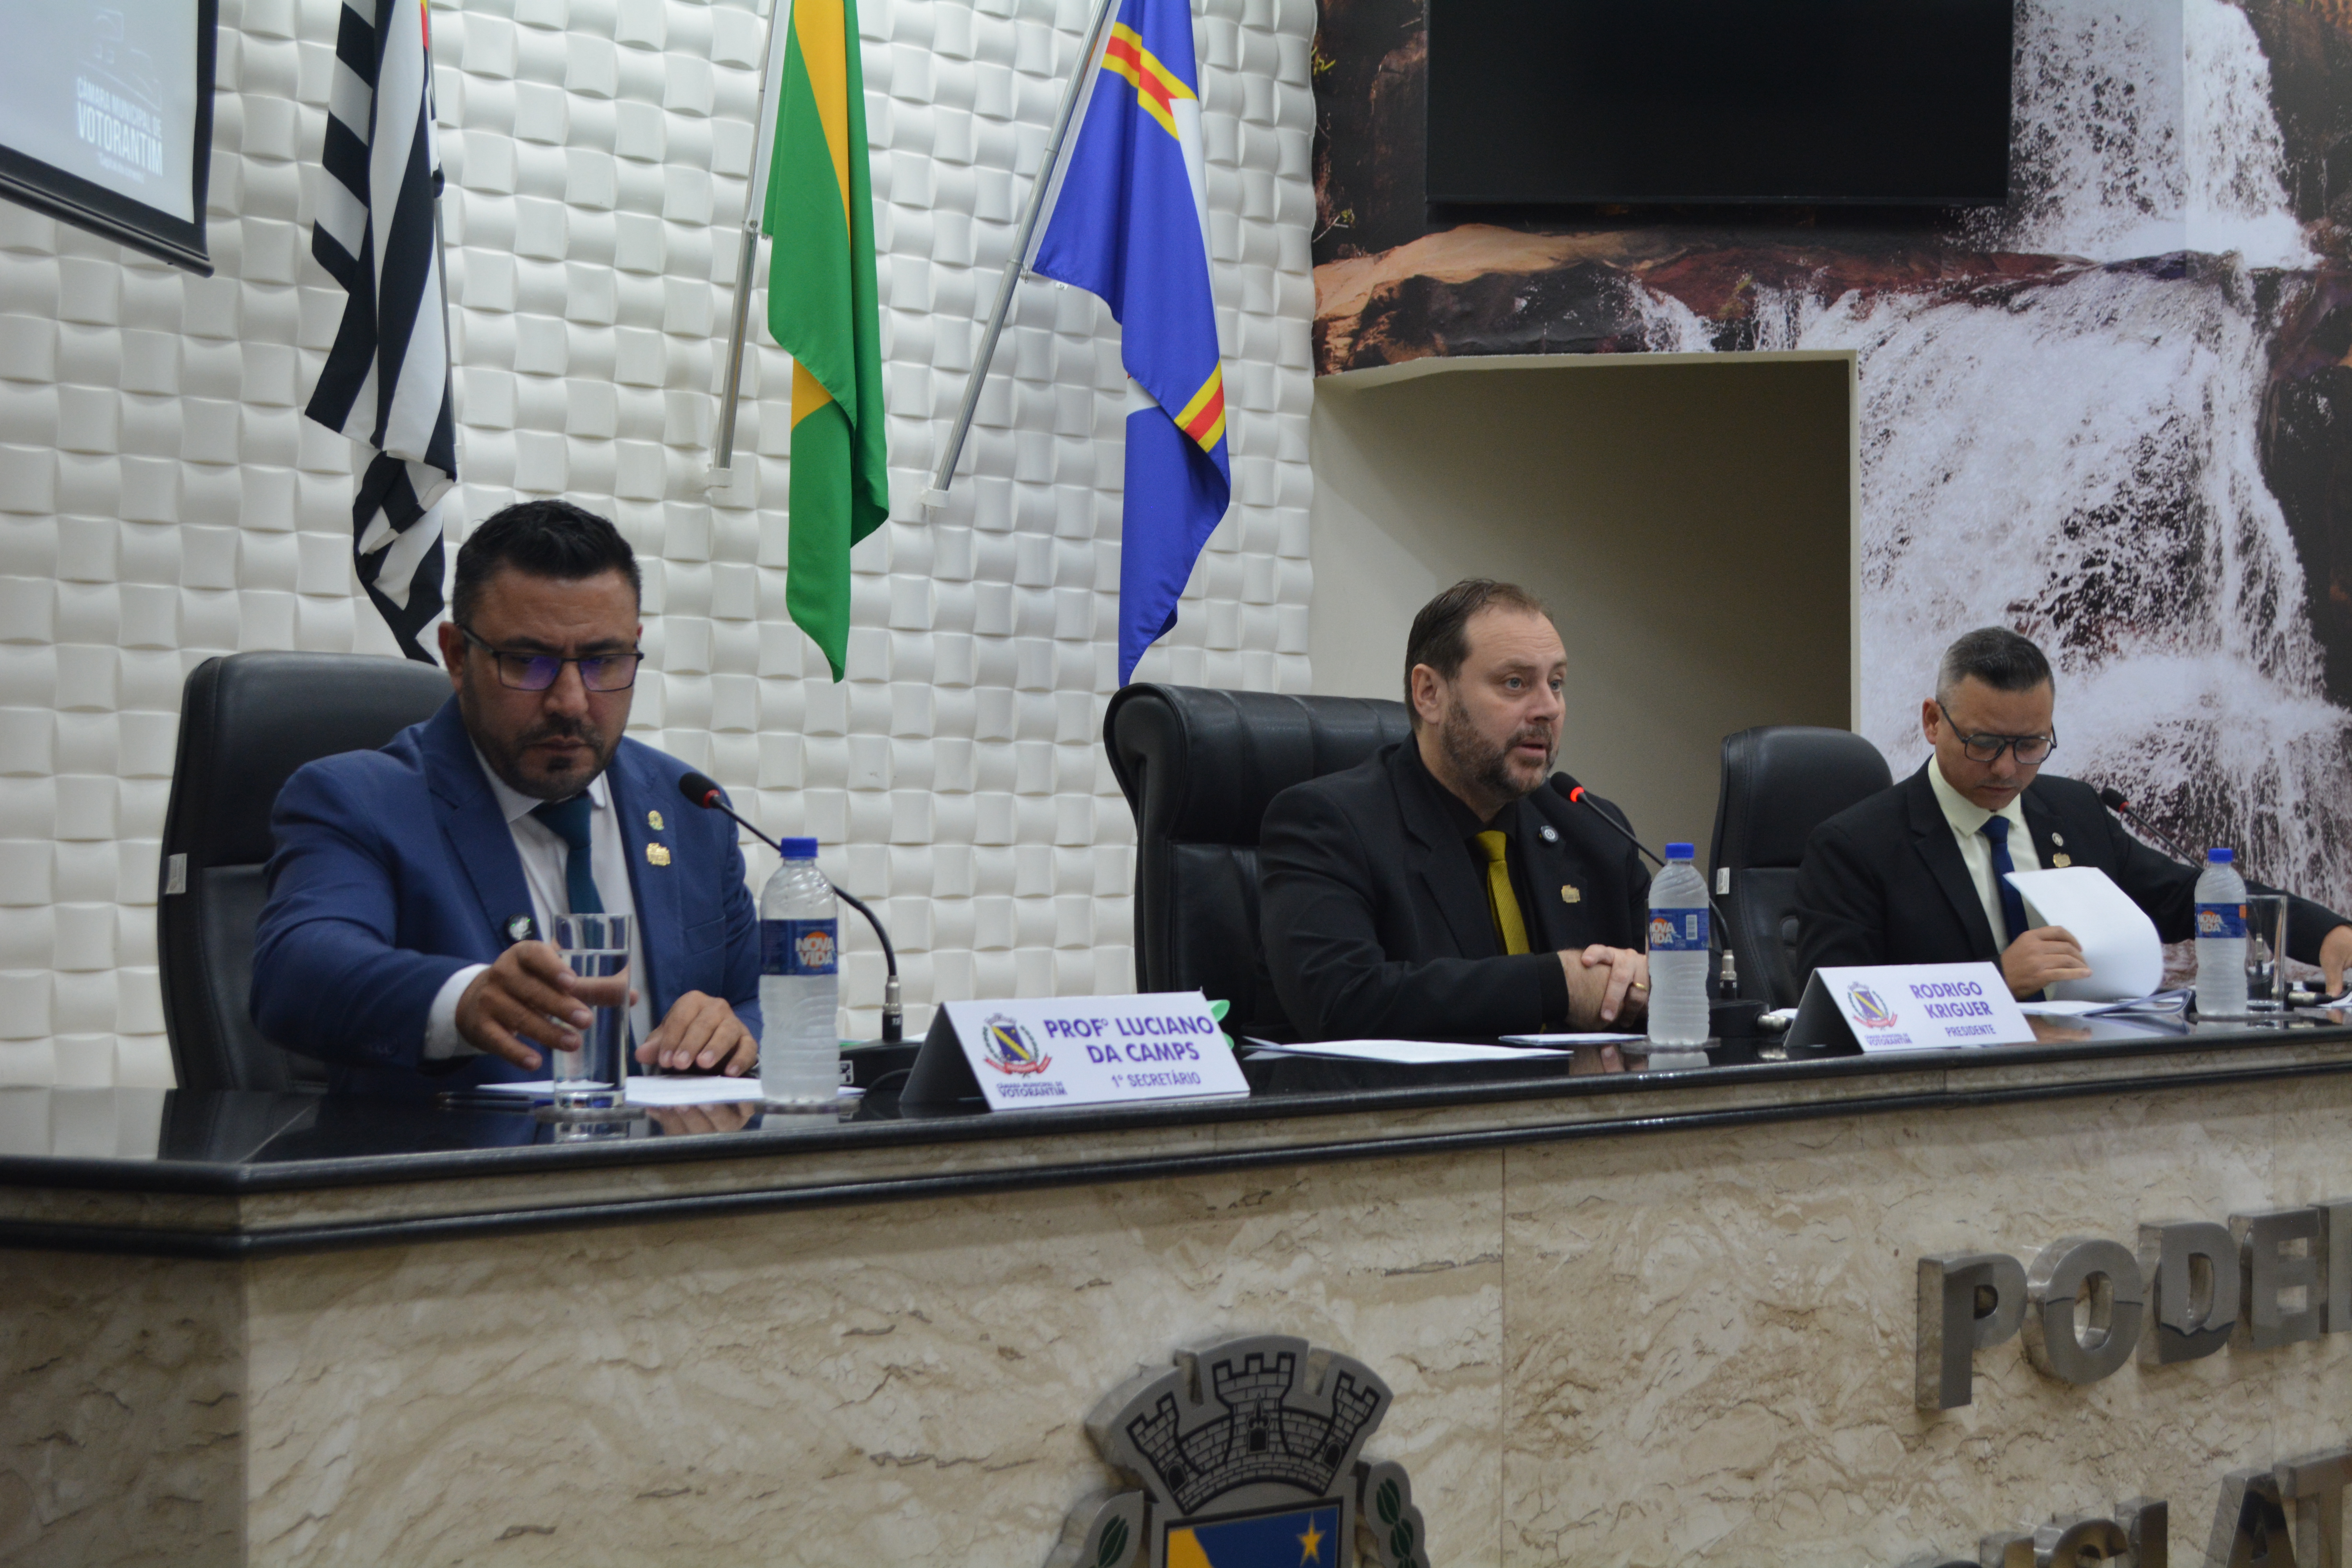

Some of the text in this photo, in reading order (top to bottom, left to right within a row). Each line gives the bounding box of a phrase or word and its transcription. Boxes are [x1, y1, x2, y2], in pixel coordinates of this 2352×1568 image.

[153, 116, 162, 138] DE
[78, 101, 162, 176] VOTORANTIM
[2198, 923, 2221, 932] VIDA
[796, 937, 835, 951] NOVA
[799, 951, 833, 965] VIDA
[1909, 981, 1982, 999] RODRIGO
[1924, 1001, 1993, 1019] KRIGUER
[1116, 1016, 1214, 1036] LUCIANO
[1945, 1024, 1996, 1037] PRESIDENTE
[1085, 1042, 1200, 1063] DA CAMPS
[1127, 1070, 1201, 1087] SECRETÁRIO
[999, 1087, 1068, 1097] VOTORANTIM
